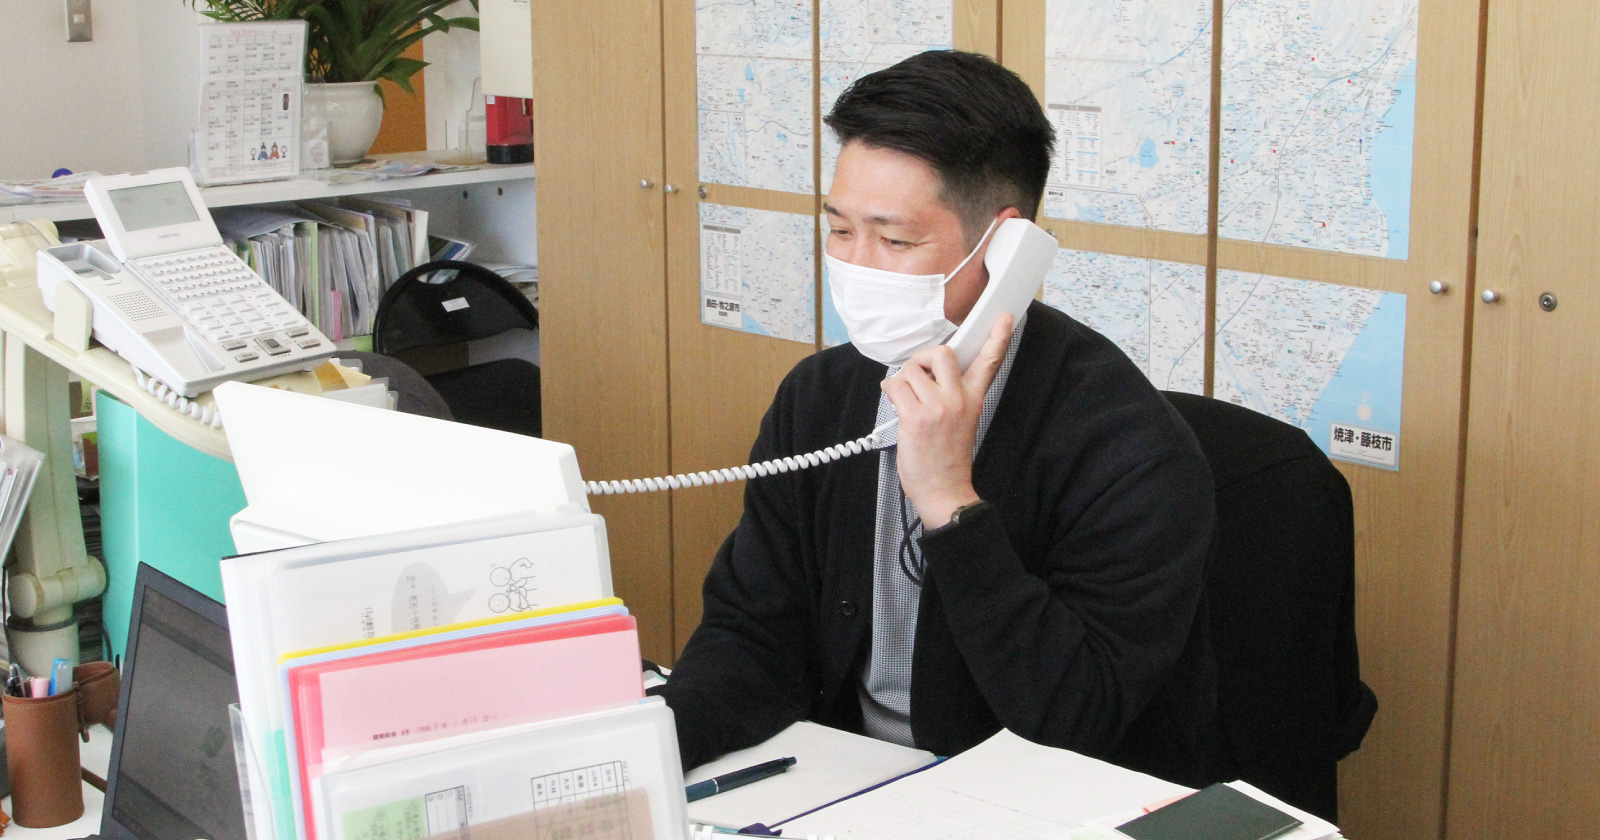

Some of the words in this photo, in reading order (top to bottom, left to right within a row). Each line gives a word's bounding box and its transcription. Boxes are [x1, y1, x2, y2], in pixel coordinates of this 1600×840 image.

[1333, 426, 1393, 451] 焼津・藤枝市
